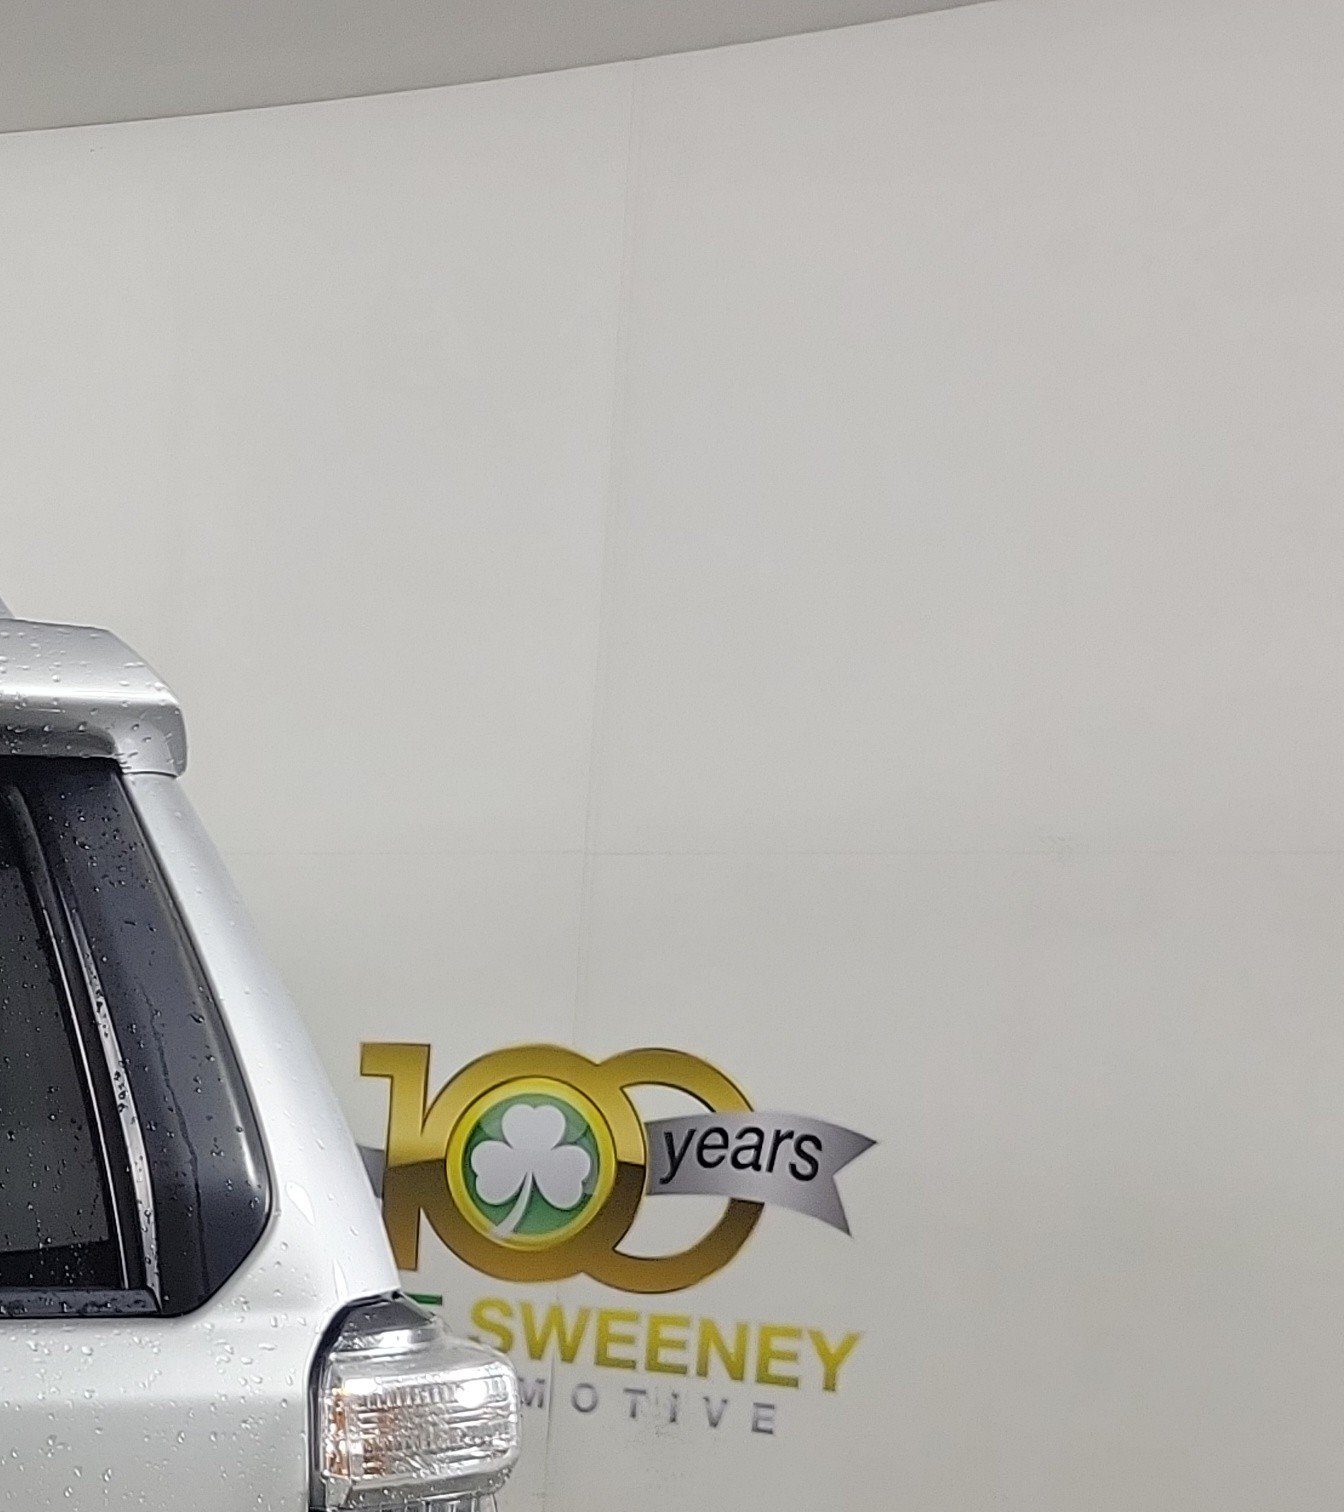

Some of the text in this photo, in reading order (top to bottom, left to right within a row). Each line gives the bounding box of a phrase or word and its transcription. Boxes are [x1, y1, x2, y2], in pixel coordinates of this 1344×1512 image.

[659, 1123, 823, 1185] years
[468, 1296, 862, 1393] SWEENEY
[518, 1376, 778, 1437] MOTIVE
